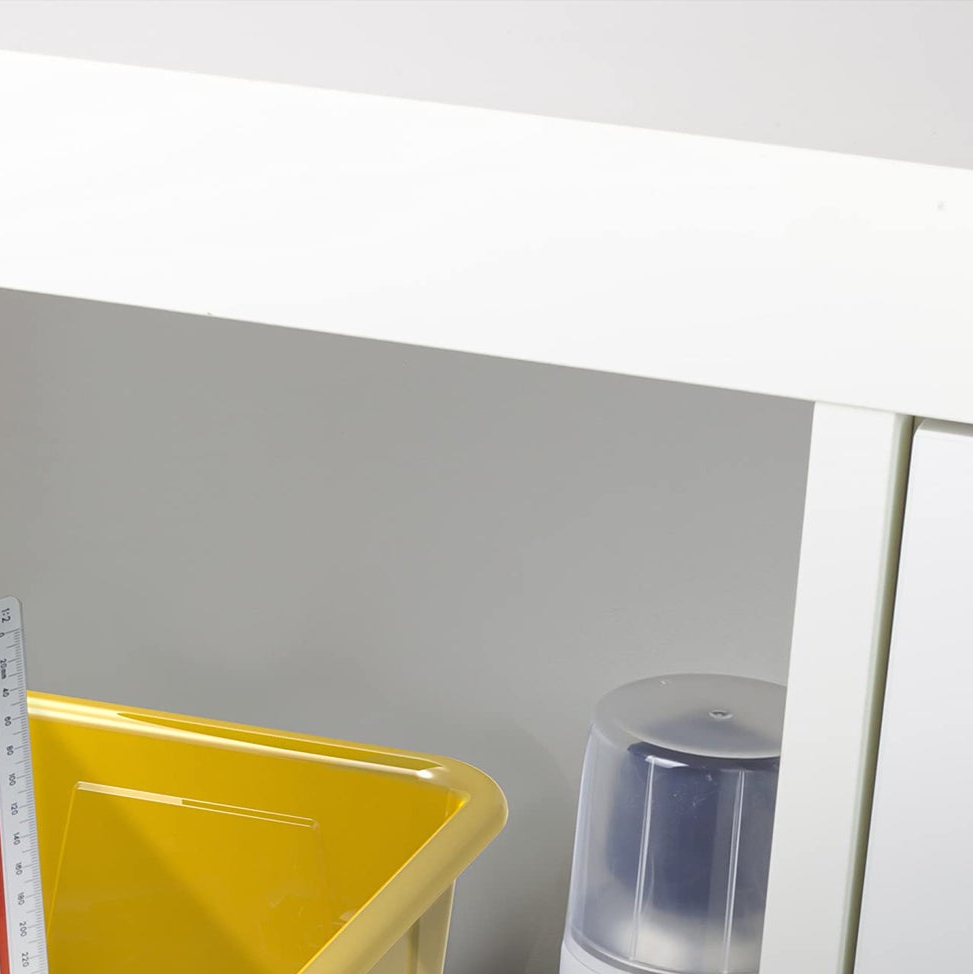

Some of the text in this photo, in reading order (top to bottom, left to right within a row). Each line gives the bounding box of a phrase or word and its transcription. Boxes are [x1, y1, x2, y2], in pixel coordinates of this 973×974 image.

[1, 608, 11, 623] 1:2
[3, 688, 9, 698] 40
[5, 716, 11, 726] 60
[7, 746, 13, 756] 80
[15, 862, 23, 876] 160
[17, 892, 25, 906] 180
[19, 922, 27, 937] 200
[21, 952, 29, 968] 220
